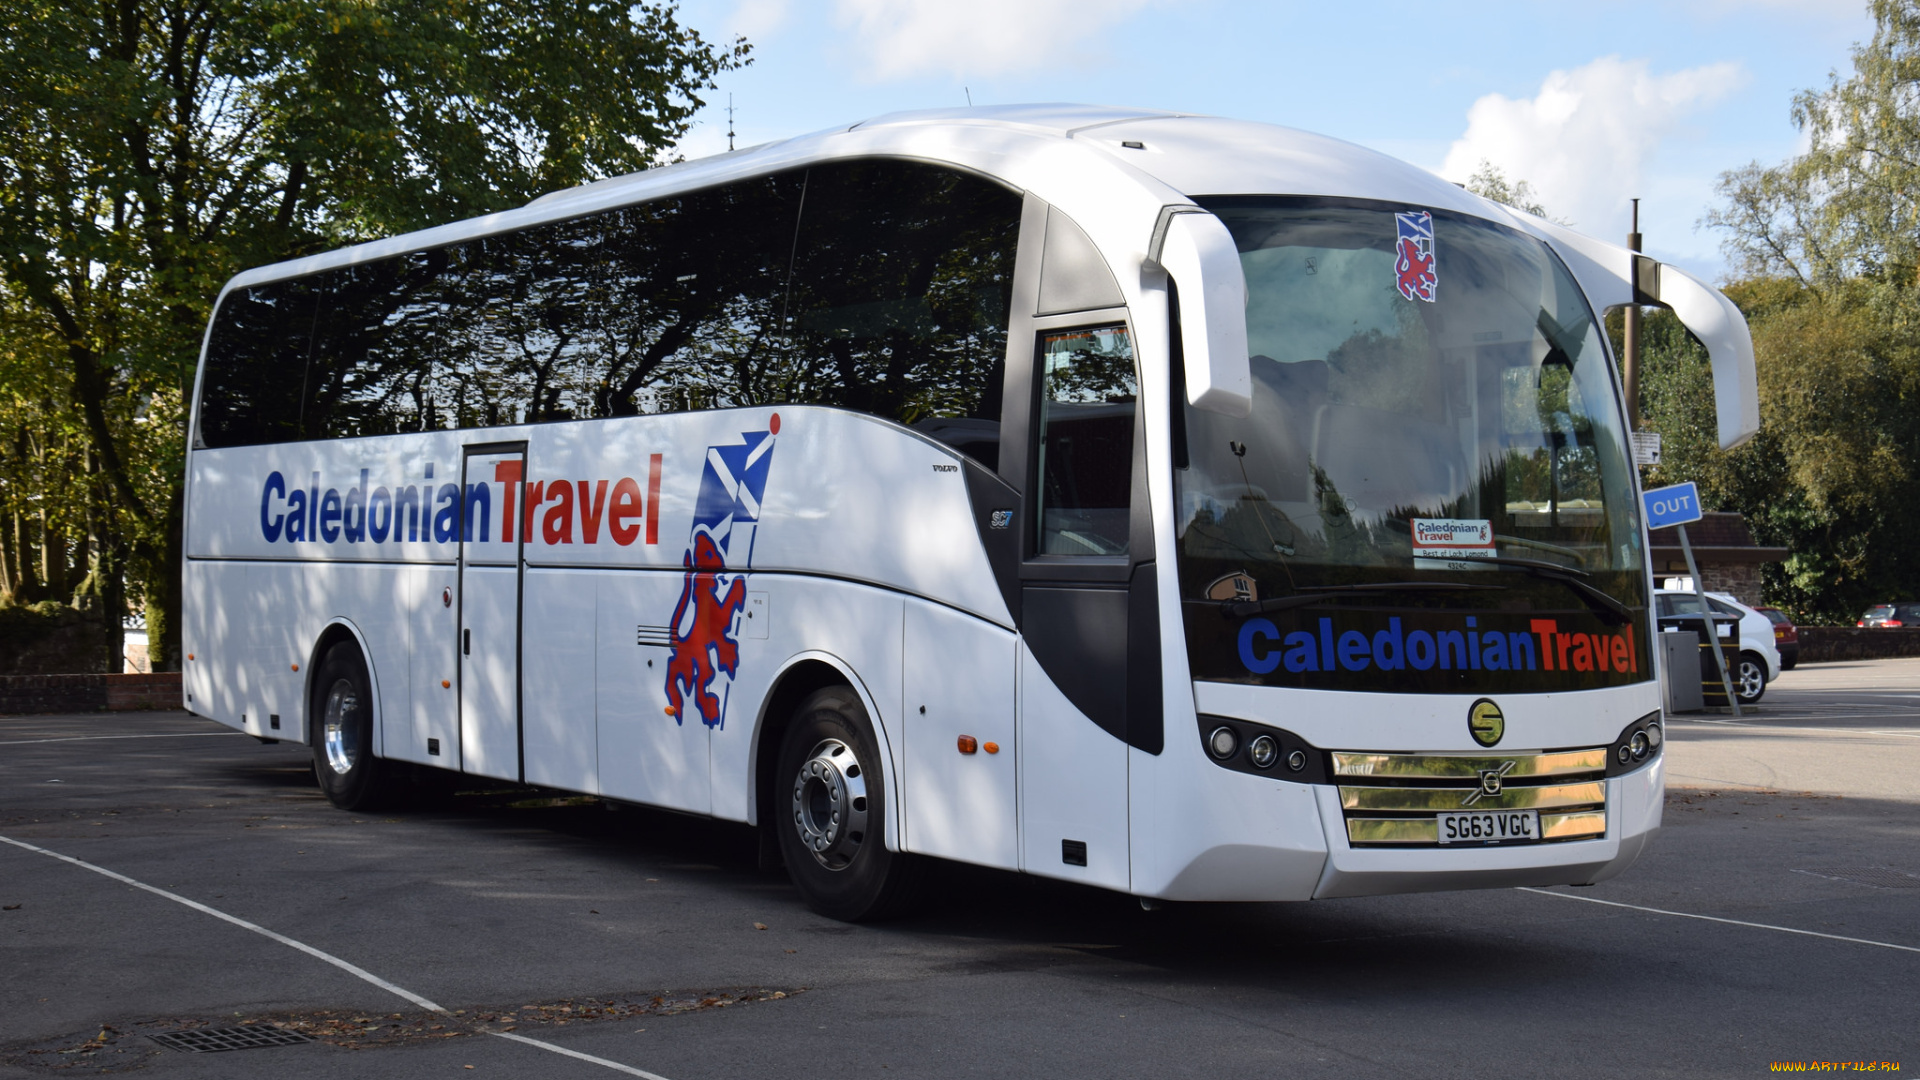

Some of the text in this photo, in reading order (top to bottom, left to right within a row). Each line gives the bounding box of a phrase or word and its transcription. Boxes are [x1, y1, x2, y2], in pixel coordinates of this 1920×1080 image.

[932, 464, 958, 472] VOLVO
[260, 453, 663, 546] Caledonian Travel
[1652, 495, 1690, 516] OUT
[991, 511, 1013, 527] SC7
[1417, 522, 1478, 533] Caledonian
[1418, 531, 1453, 541] Travel
[1422, 549, 1489, 557] Best of Loch Lomond
[1237, 615, 1638, 675] Caledonian Travel
[1445, 813, 1531, 839] SG63 VGC
